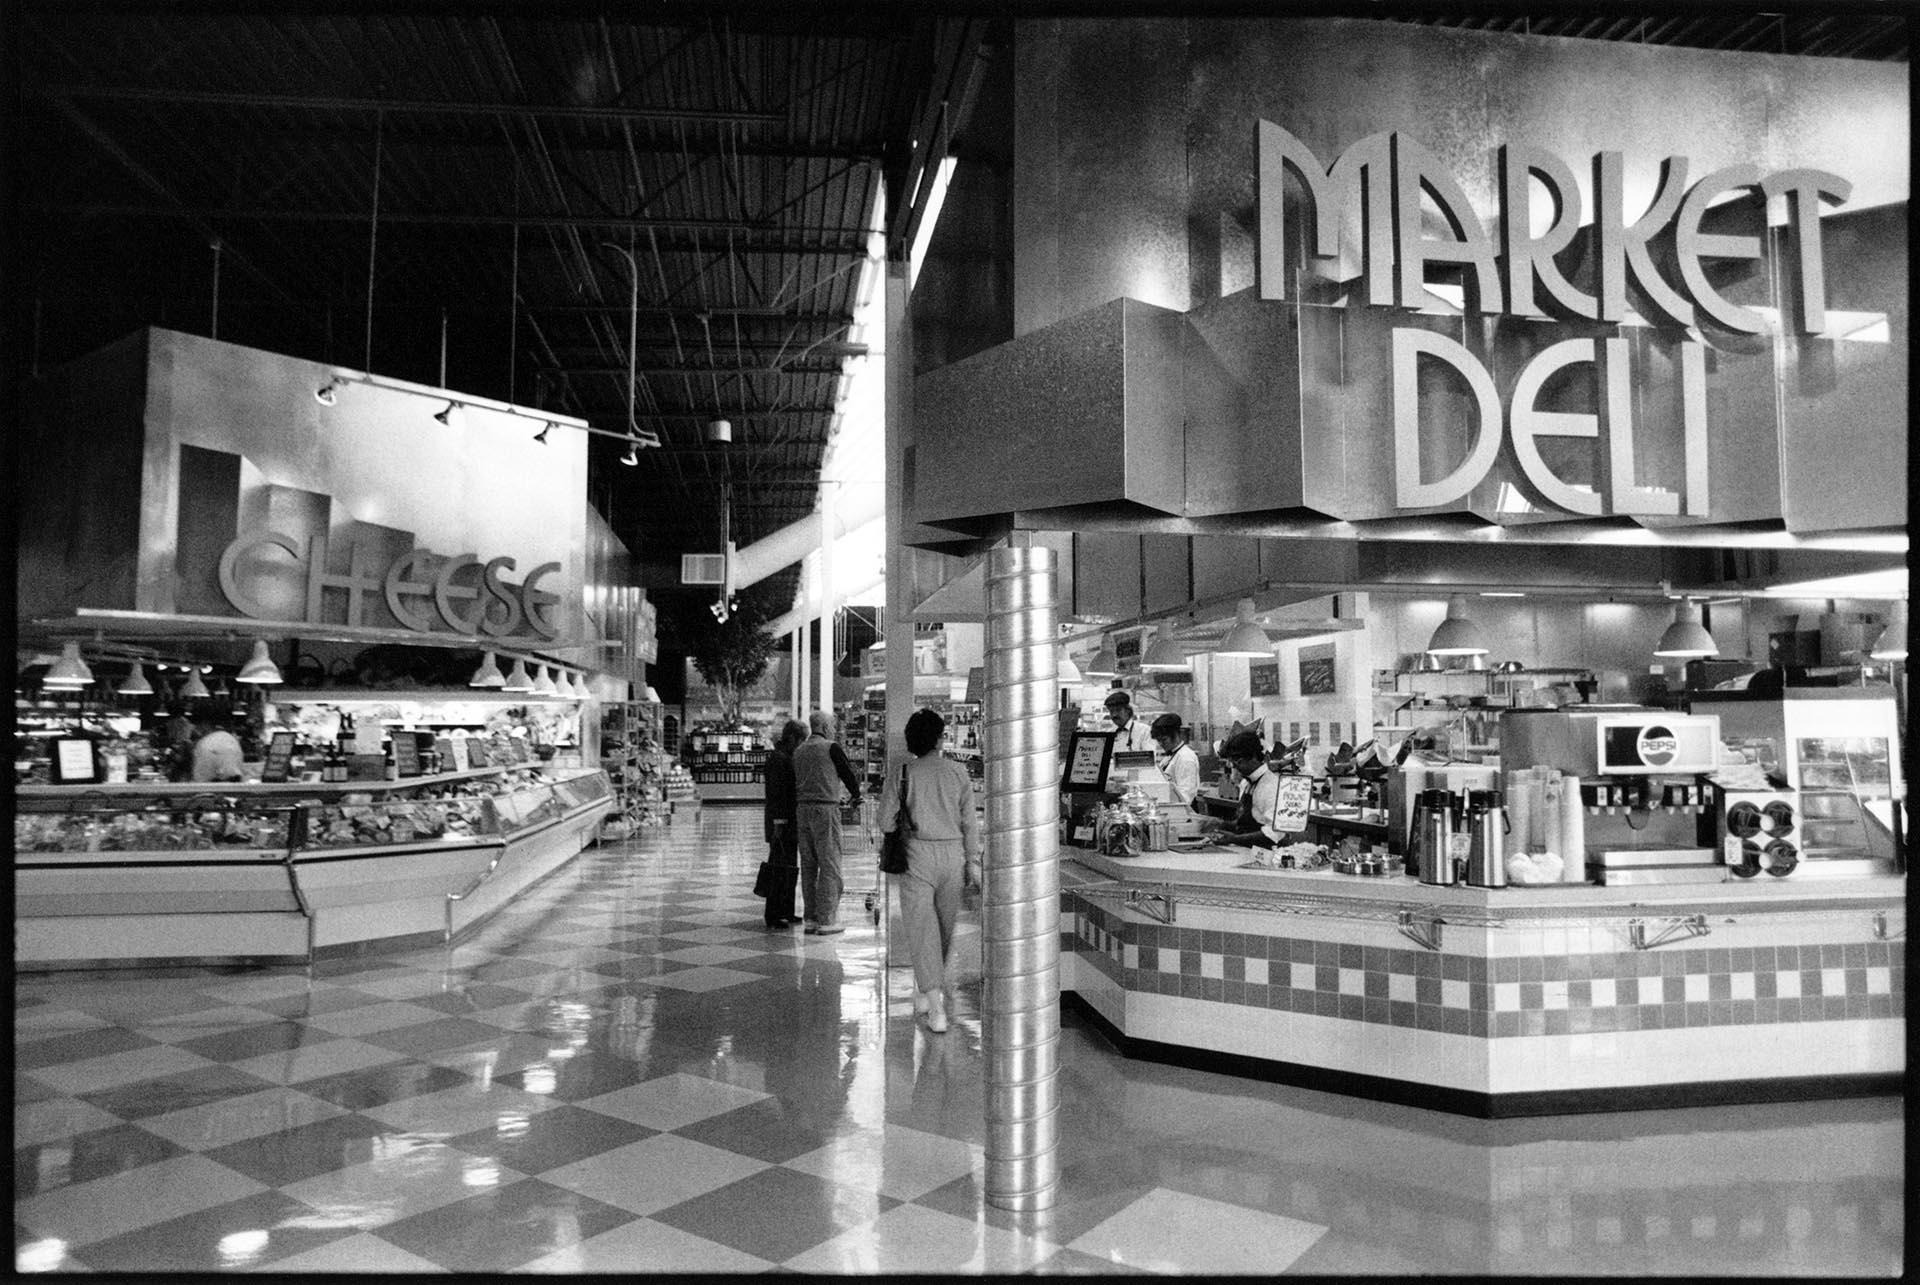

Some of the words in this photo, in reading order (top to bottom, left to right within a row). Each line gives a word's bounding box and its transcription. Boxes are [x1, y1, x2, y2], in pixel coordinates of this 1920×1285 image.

[1256, 119, 1853, 334] MARKET
[1392, 328, 1708, 515] DELI
[219, 532, 562, 638] CHEESE
[1641, 740, 1677, 751] PEPSI
